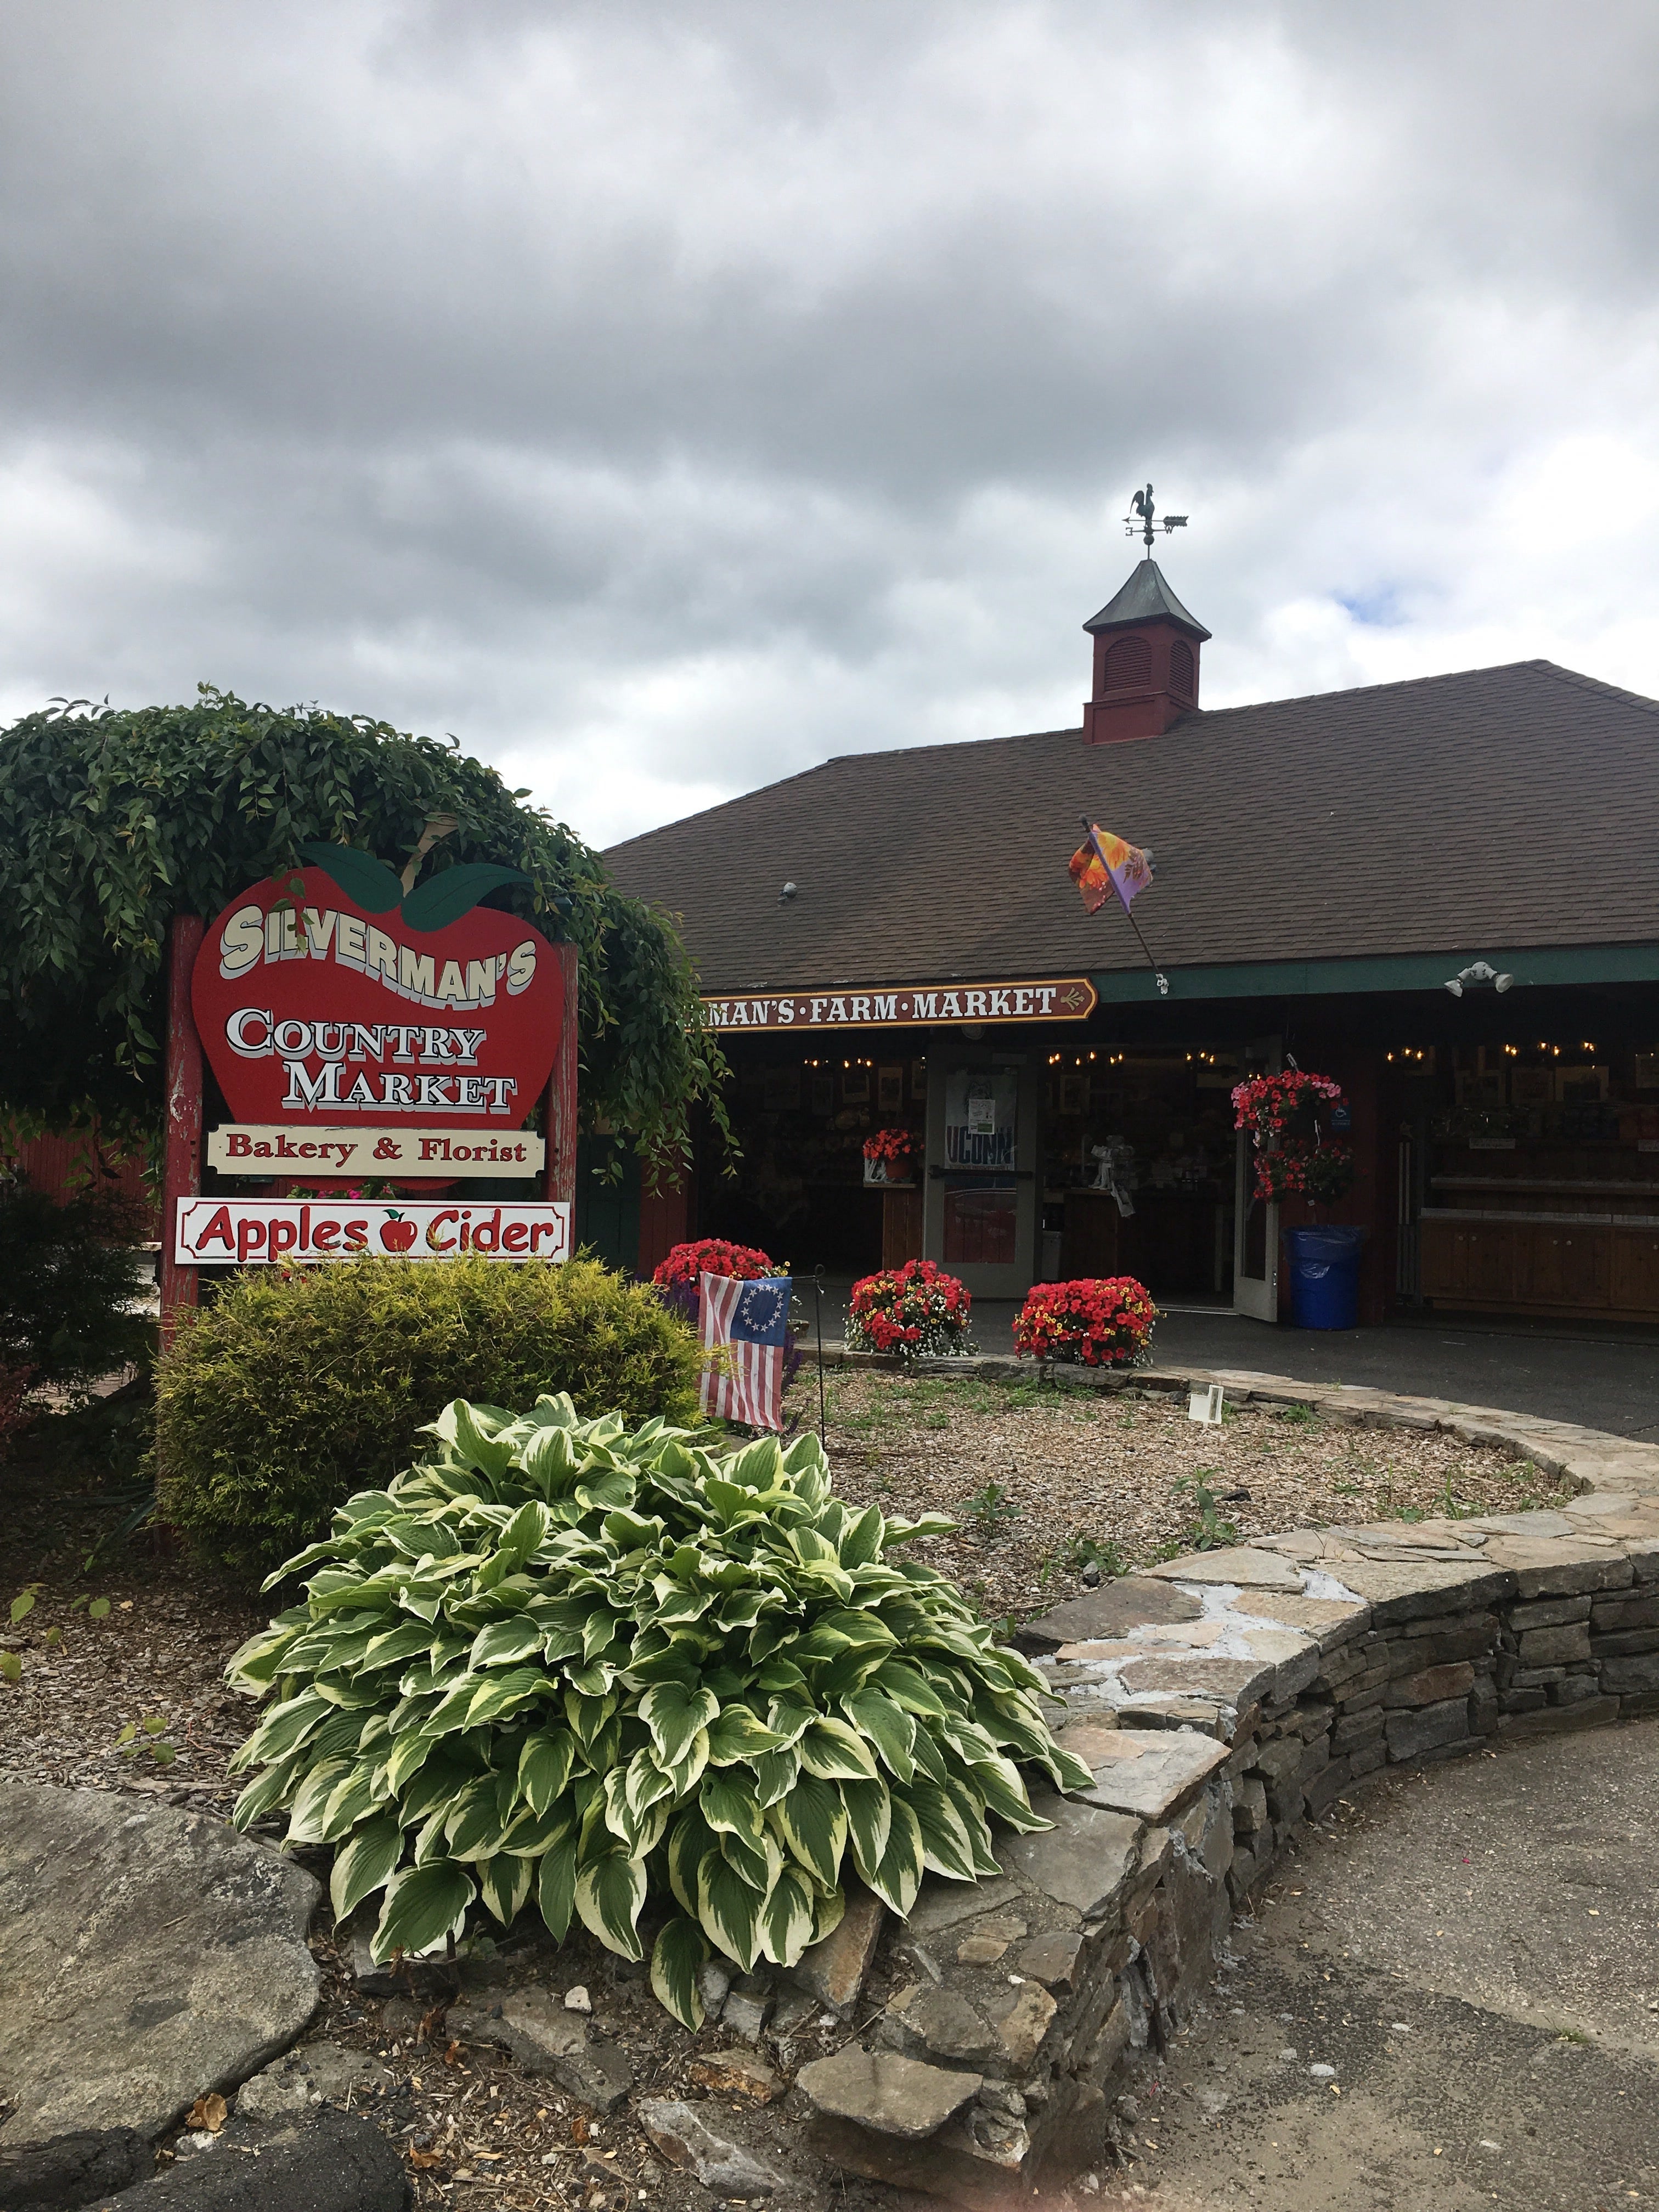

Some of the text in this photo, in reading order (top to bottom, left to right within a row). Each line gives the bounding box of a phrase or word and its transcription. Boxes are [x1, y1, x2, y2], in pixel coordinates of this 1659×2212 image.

[219, 904, 537, 1010] SILVERMAN'S
[687, 988, 1057, 1027] MAN'S FARM MARKET
[225, 1008, 486, 1066] COUNTRY
[282, 1060, 518, 1114] MARKET
[225, 1133, 527, 1167] Bakery & Florist
[946, 1126, 1013, 1165] UCONN
[196, 1205, 553, 1261] Apples Cider
